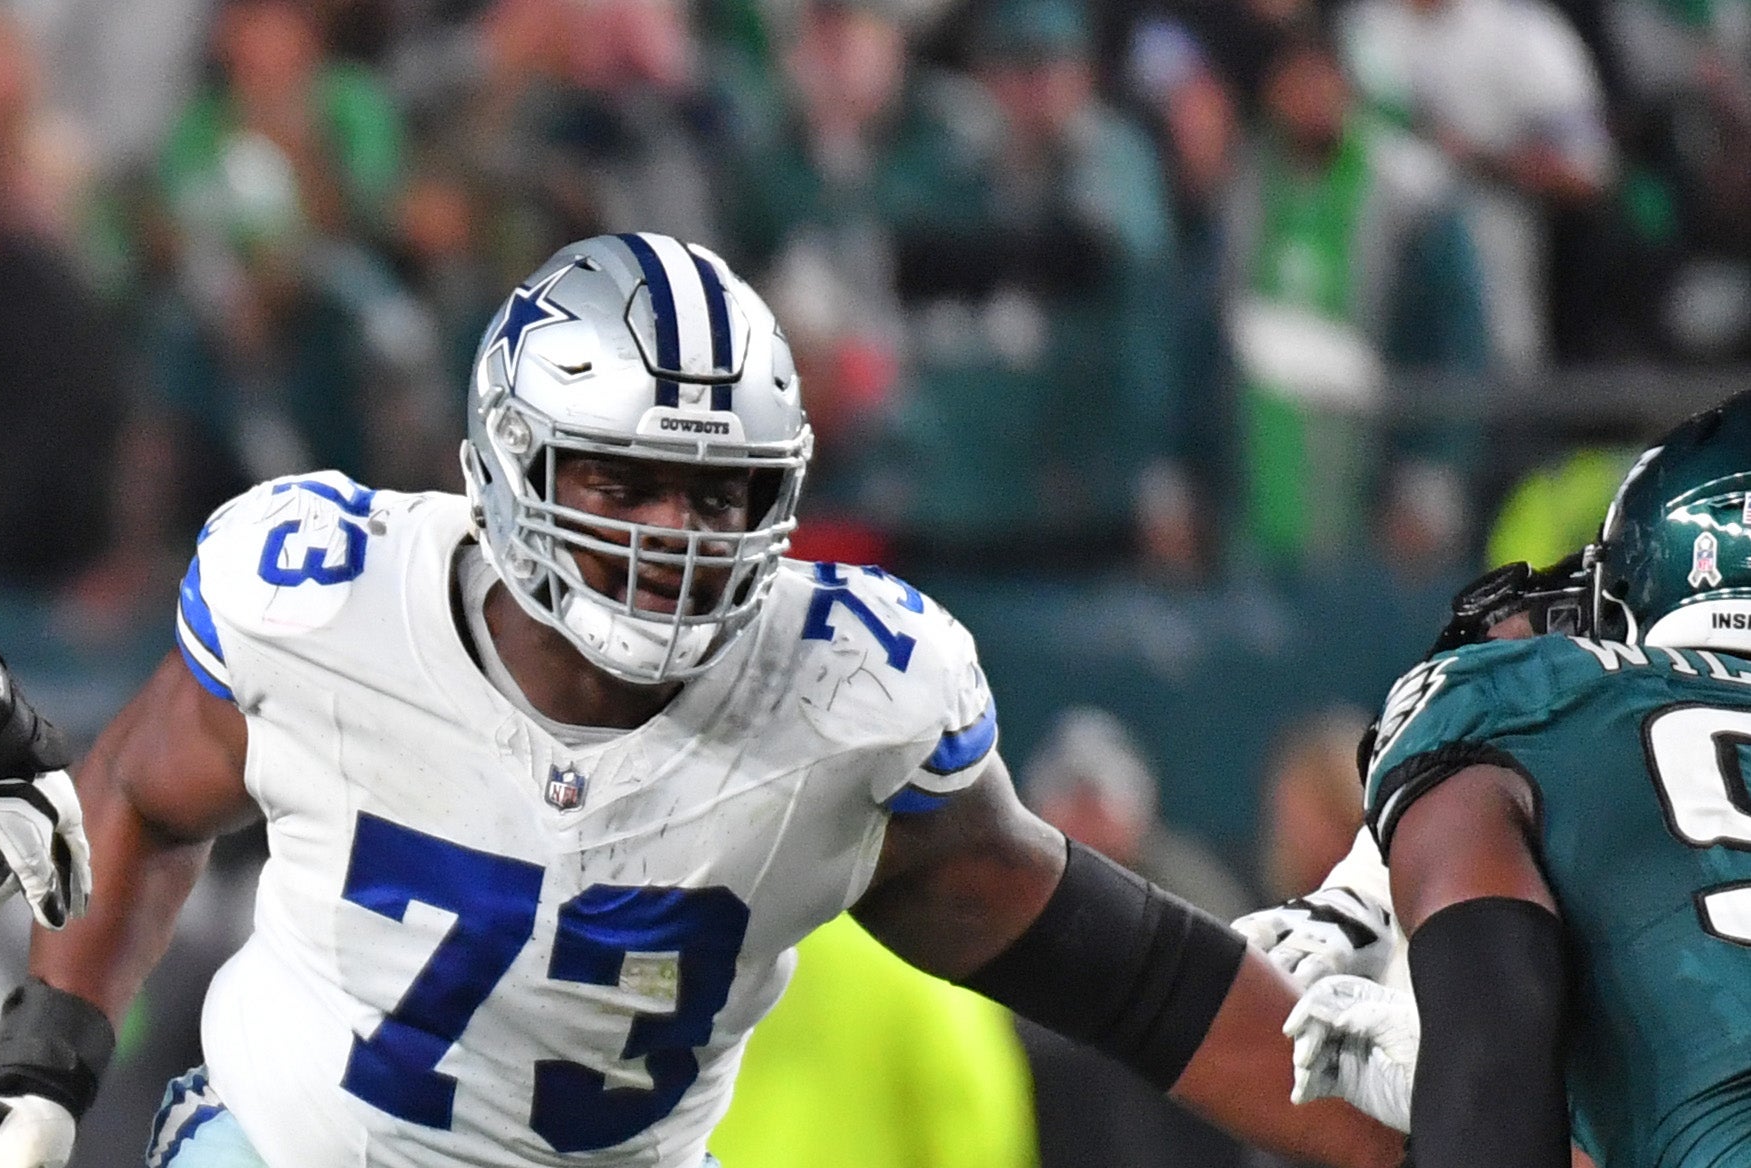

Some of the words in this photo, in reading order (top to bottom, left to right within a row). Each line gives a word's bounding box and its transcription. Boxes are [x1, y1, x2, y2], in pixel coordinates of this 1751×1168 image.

[660, 417, 730, 435] COWBOYS
[257, 479, 377, 588] 73
[340, 810, 751, 1153] 73
